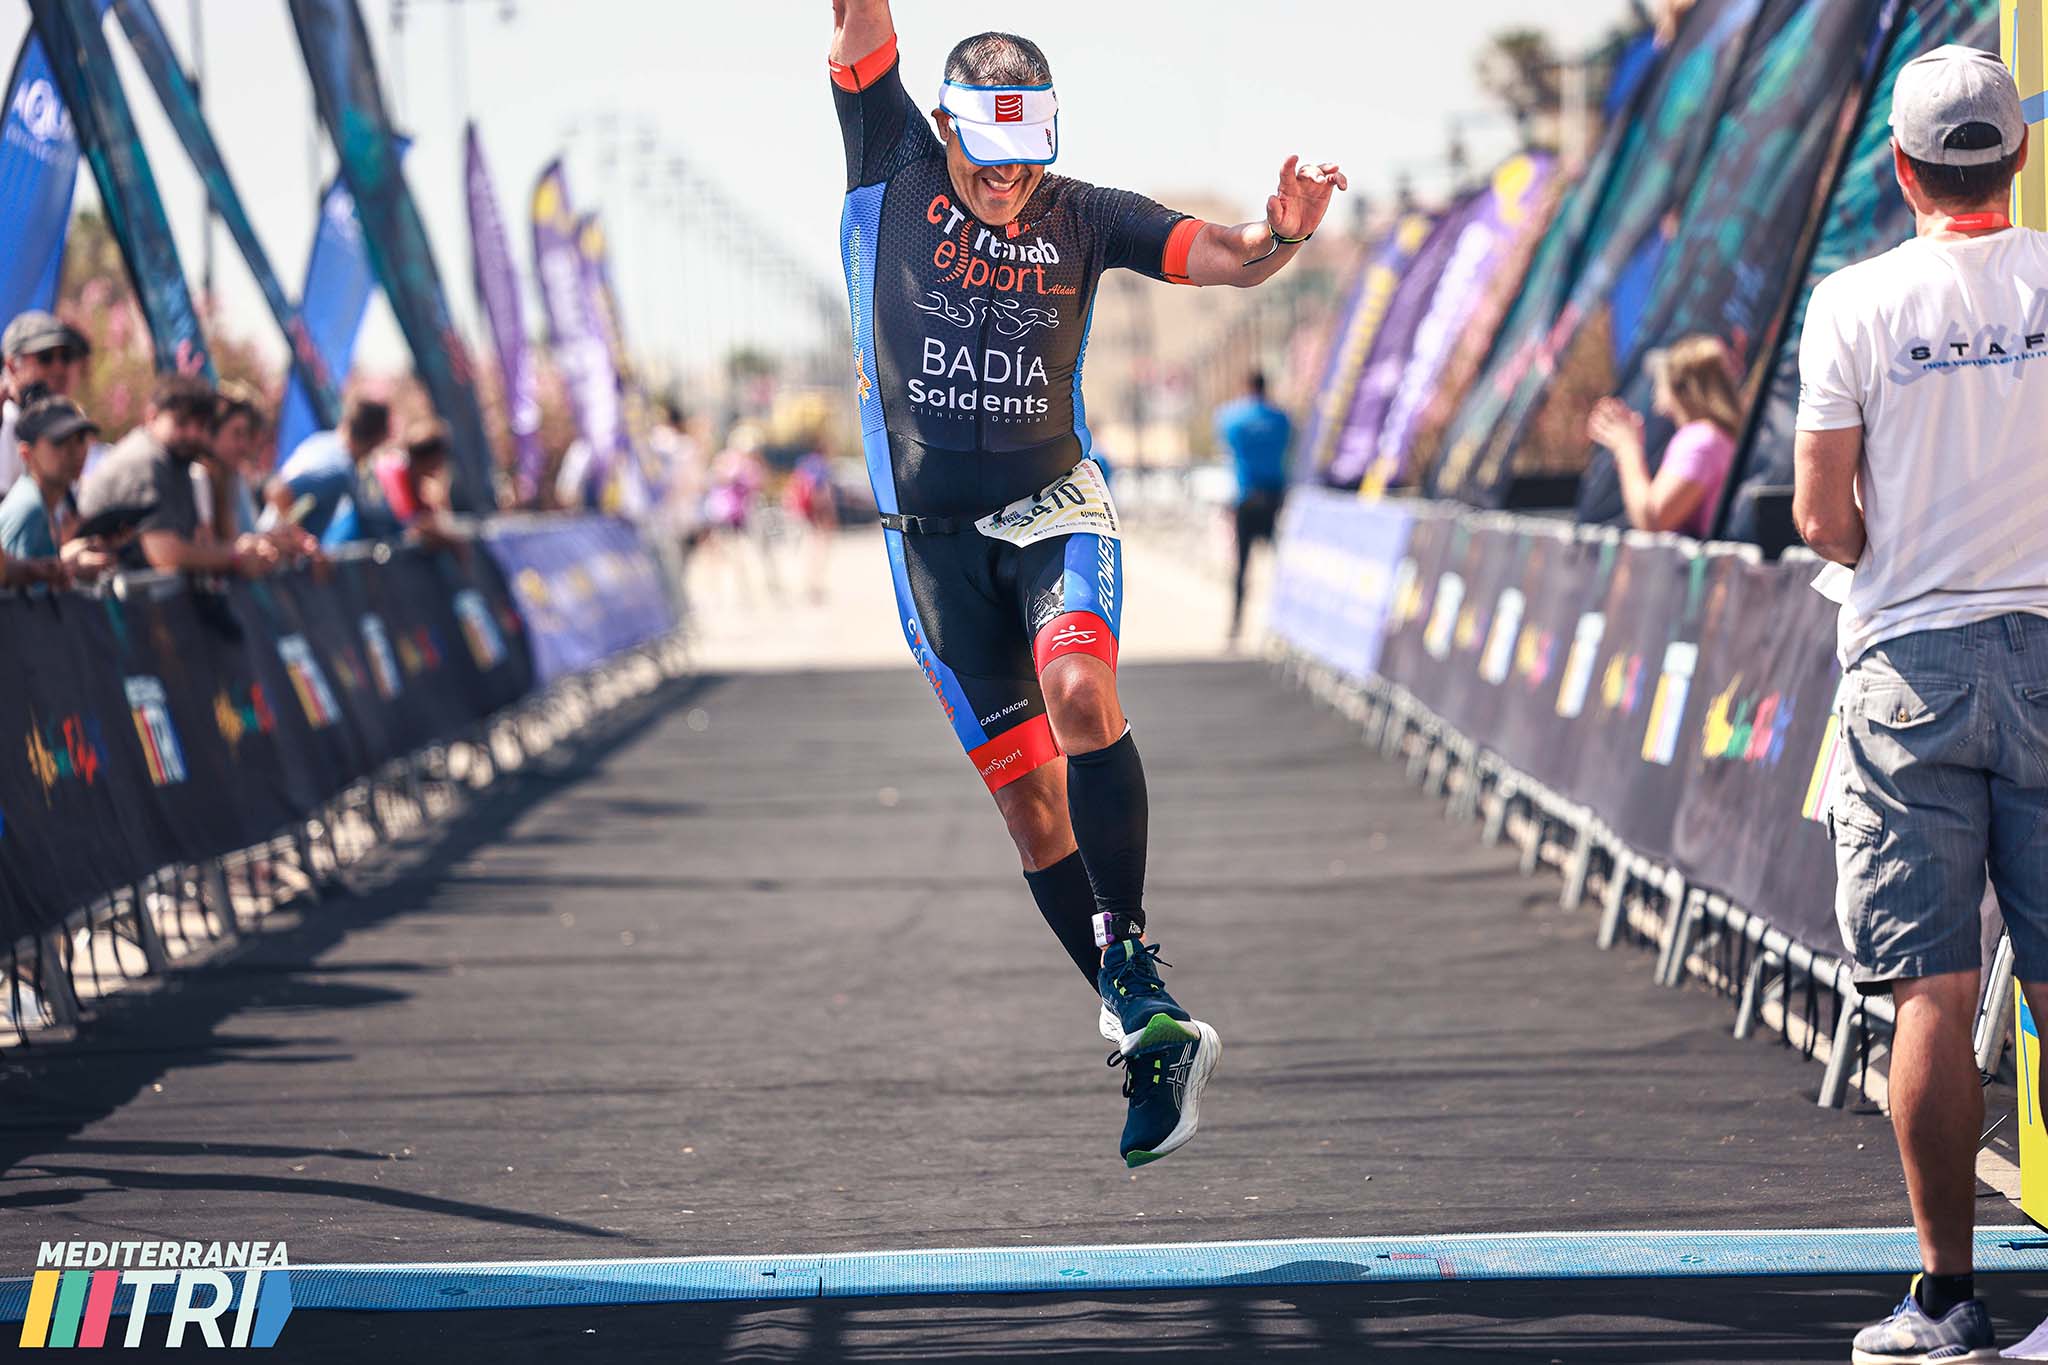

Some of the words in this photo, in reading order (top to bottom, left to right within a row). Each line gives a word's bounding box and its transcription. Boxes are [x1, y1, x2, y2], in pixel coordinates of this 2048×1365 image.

[922, 336, 1049, 387] BADÍA
[907, 379, 1050, 415] Soldents
[980, 712, 1001, 727] CASA
[1002, 698, 1029, 716] NACHO
